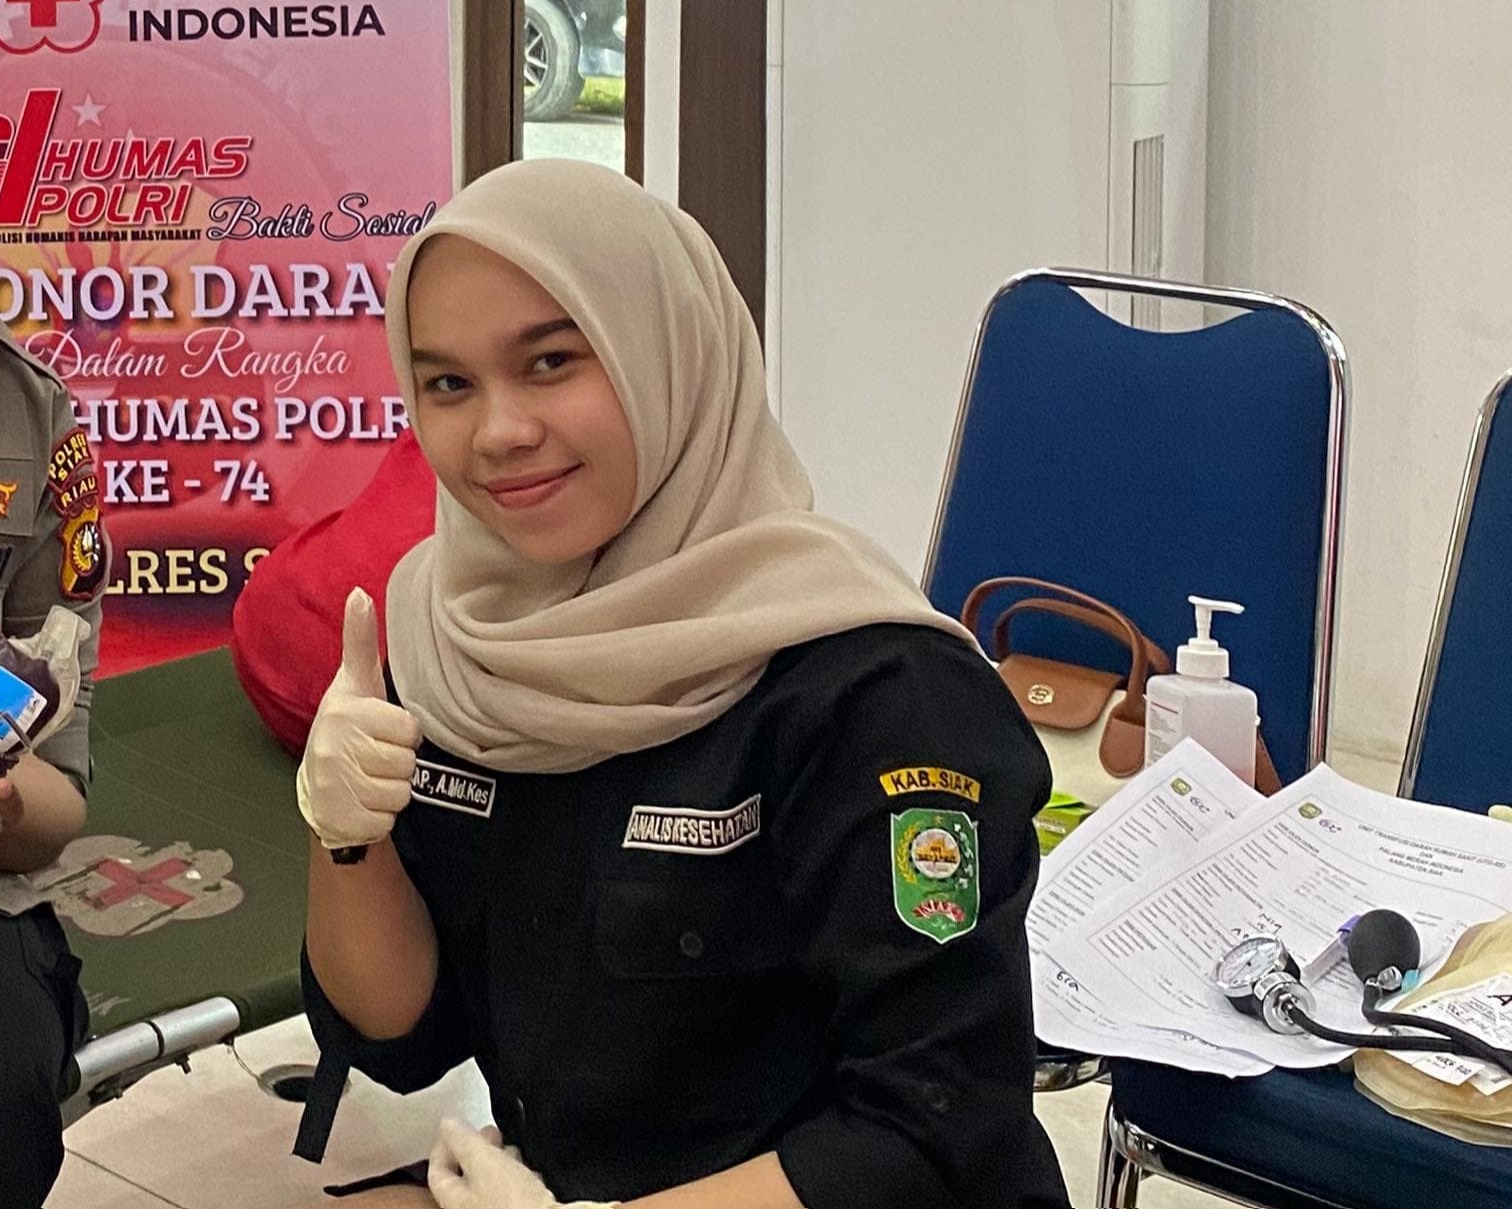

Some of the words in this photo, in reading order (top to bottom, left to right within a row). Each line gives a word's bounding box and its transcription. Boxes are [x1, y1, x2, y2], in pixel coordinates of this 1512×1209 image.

[128, 3, 386, 42] INDONESIA
[39, 135, 252, 181] HUMAS
[25, 182, 192, 227] POLRI
[206, 195, 315, 241] Bakti
[320, 192, 437, 242] Sosial
[25, 231, 76, 244] HUMANIS
[78, 230, 128, 242] HARAPAN
[130, 228, 202, 242] MASYARAKAT
[189, 262, 395, 319] DARA
[24, 327, 169, 380] Dalam
[179, 326, 352, 394] Rangka
[71, 395, 261, 442] HUMAS
[61, 476, 96, 508] RIAU
[103, 459, 170, 503] KE
[213, 459, 270, 502] 74
[890, 769, 937, 792] KAB.
[939, 771, 974, 799] SIAK
